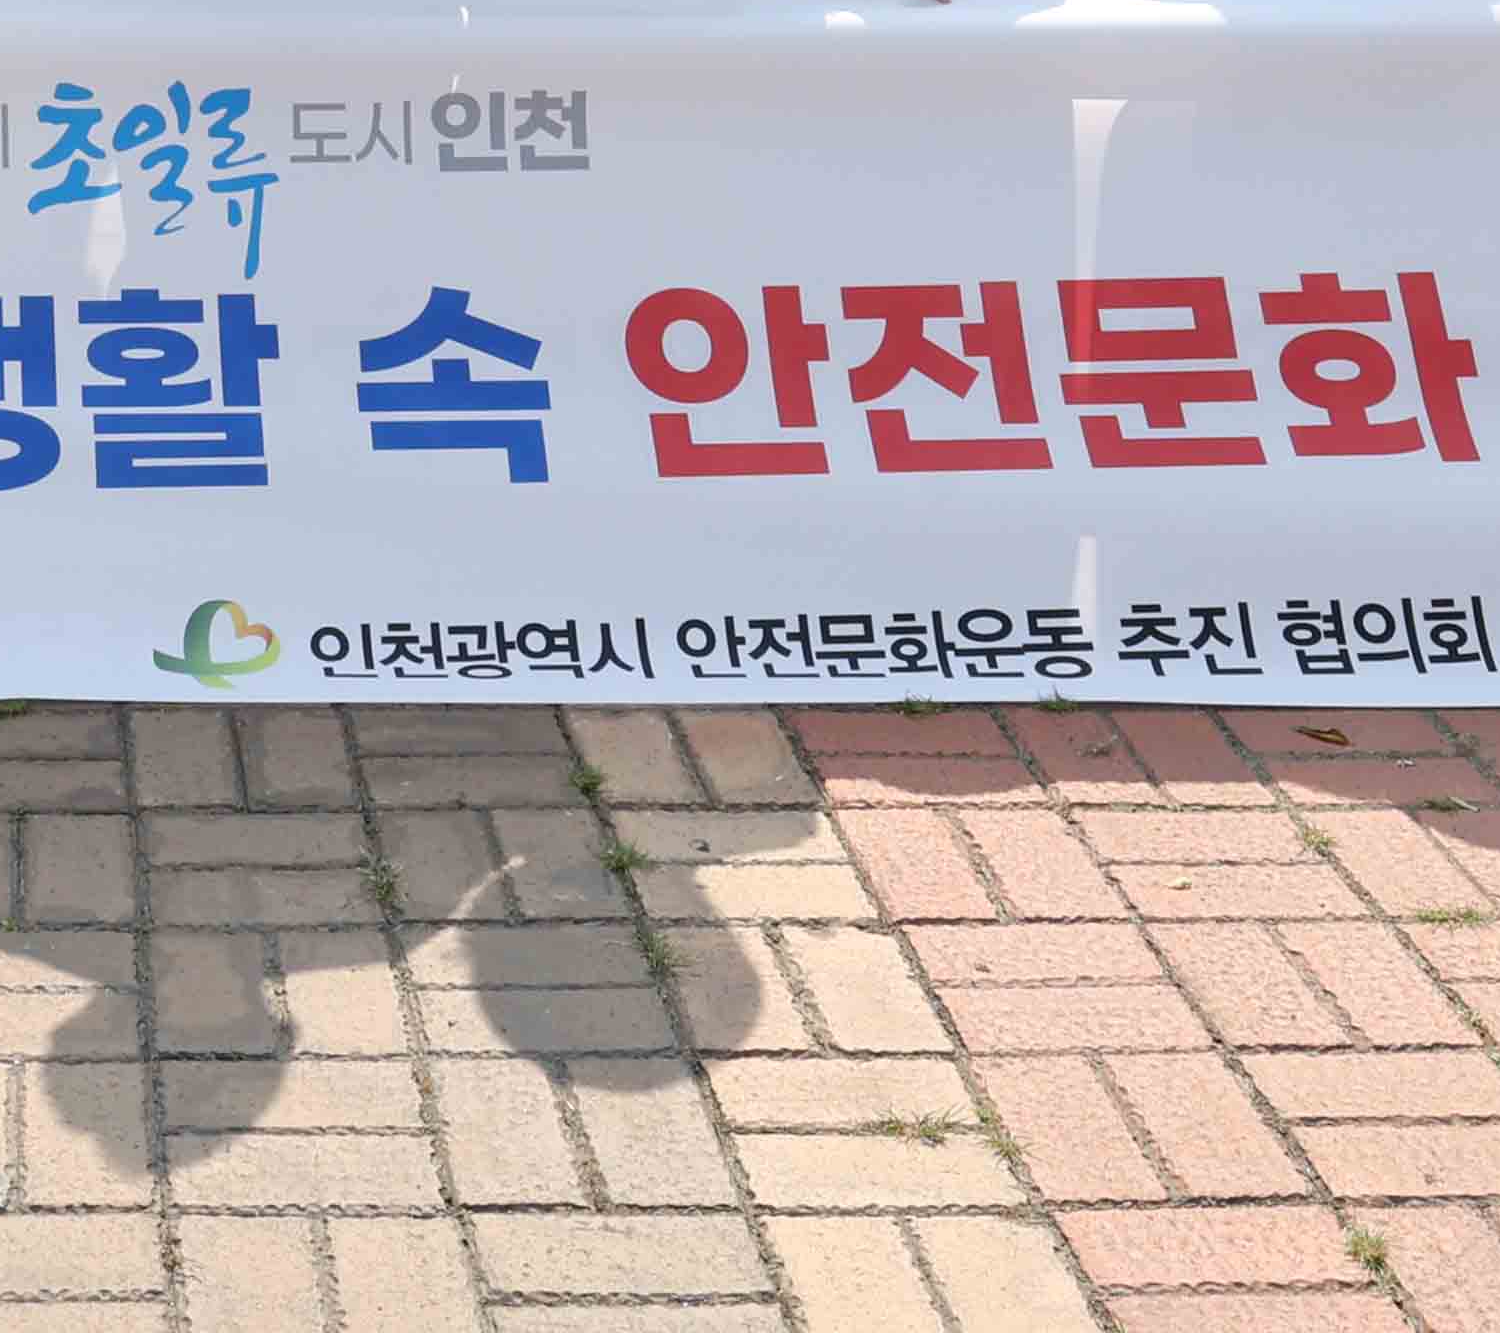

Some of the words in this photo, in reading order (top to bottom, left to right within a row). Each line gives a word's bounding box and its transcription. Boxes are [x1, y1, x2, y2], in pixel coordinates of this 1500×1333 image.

[27, 80, 280, 278] 초일류
[289, 100, 415, 168] 도시
[430, 90, 591, 173] 인천
[356, 288, 553, 485] 속
[623, 271, 1483, 481] 안전문화
[306, 617, 657, 682] 인천광역시
[675, 603, 1096, 682] 안전문화운동
[1114, 599, 1261, 677] 추진
[1276, 594, 1499, 676] 협의회
